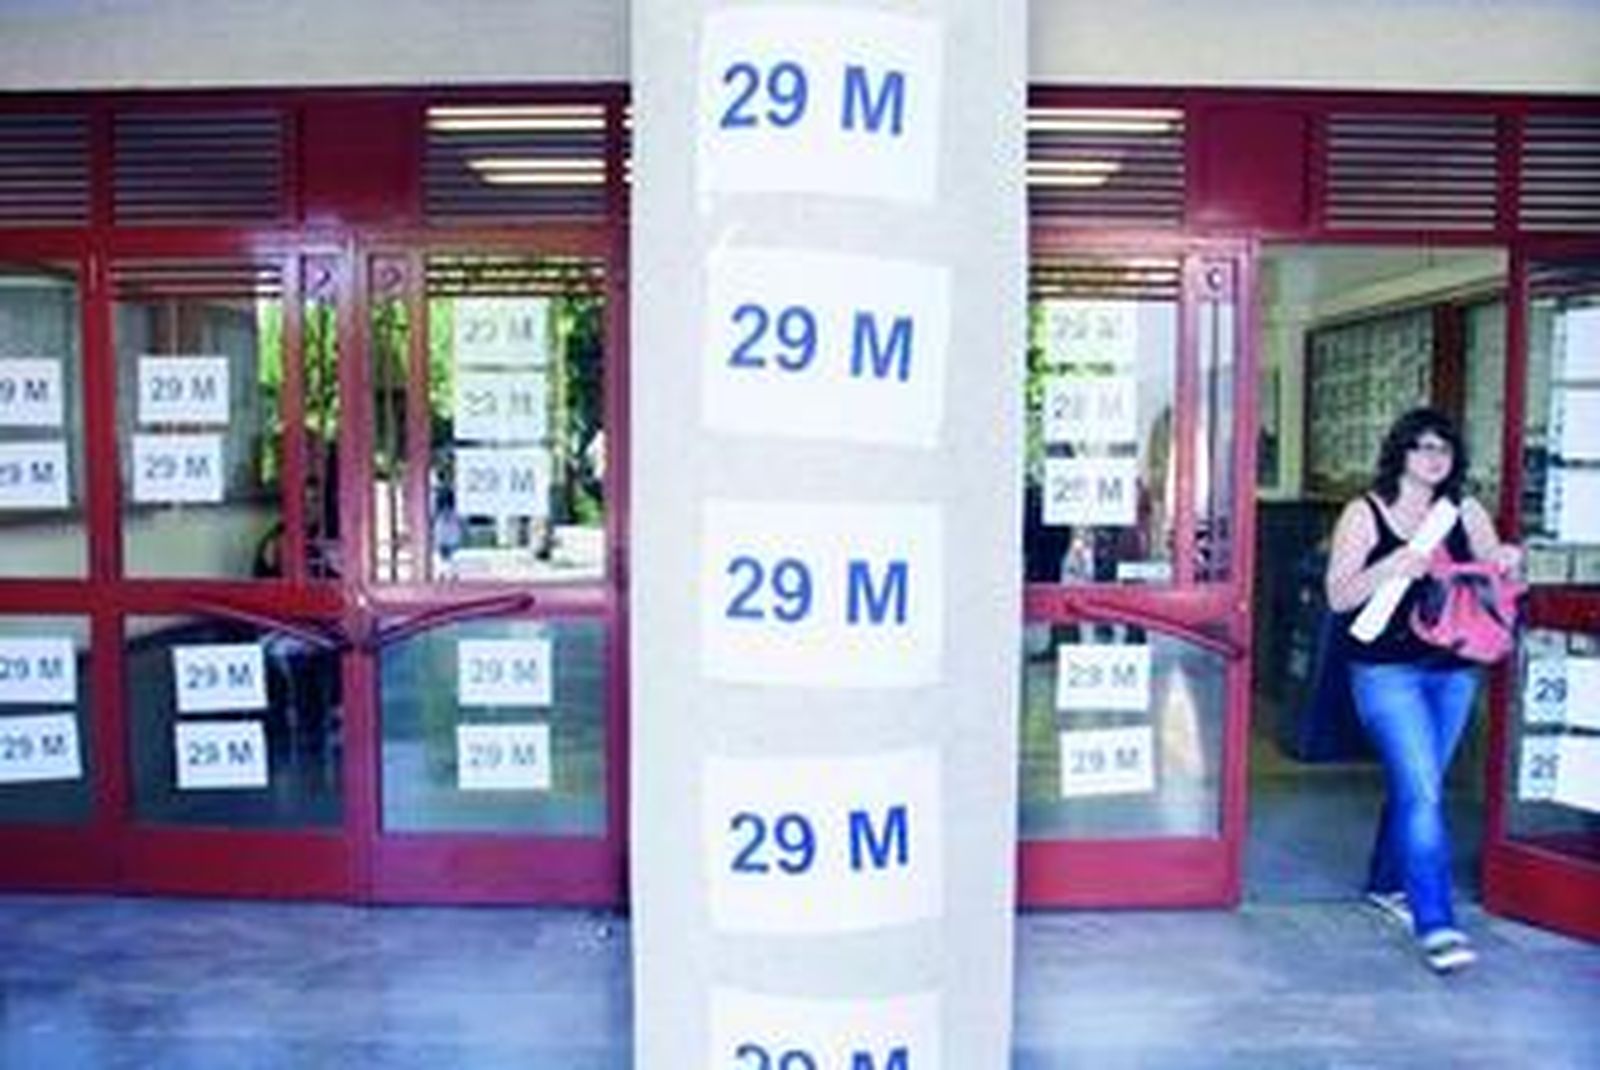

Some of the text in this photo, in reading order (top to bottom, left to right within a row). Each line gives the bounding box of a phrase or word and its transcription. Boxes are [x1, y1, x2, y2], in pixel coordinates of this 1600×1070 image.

[720, 62, 907, 136] 29 M
[728, 303, 914, 382] 29 M
[25, 378, 48, 403] M
[151, 375, 217, 403] 29 M
[31, 460, 54, 484] M
[144, 455, 210, 480] 29 M
[468, 466, 535, 494] 29 M
[725, 556, 910, 625] 29 M
[38, 656, 64, 681] M
[187, 662, 254, 690] 29 M
[468, 658, 537, 686] 29 M
[1068, 662, 1138, 690] 29 M
[1535, 676, 1568, 704] 29
[3, 733, 67, 761] 29 M
[188, 740, 254, 767] 29 M
[468, 742, 537, 769] 29 M
[1069, 746, 1140, 776] 29 M
[728, 805, 910, 875] 29 M
